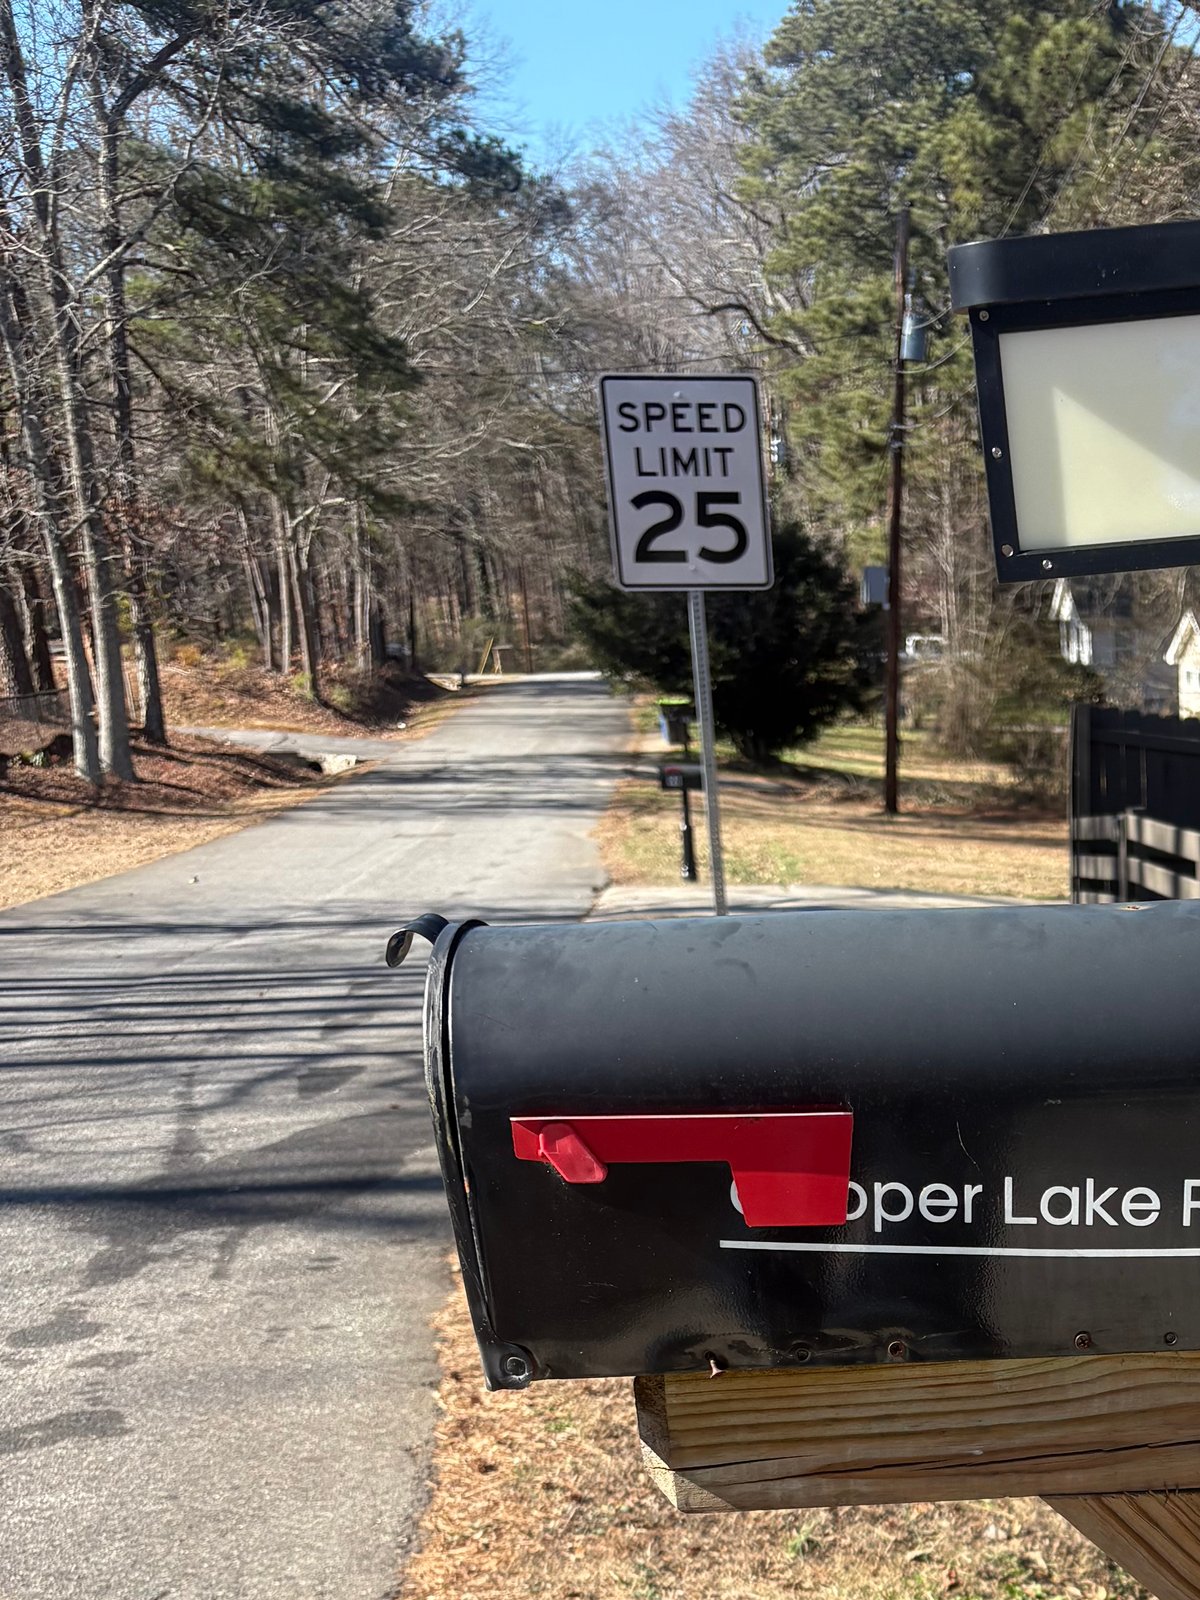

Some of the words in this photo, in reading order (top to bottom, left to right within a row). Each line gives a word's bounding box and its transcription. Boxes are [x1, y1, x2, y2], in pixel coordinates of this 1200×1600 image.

[617, 402, 747, 433] SPEED
[634, 446, 735, 477] LIMIT
[629, 490, 748, 564] 25
[730, 1180, 983, 1232] oper
[1004, 1176, 1161, 1227] Lake
